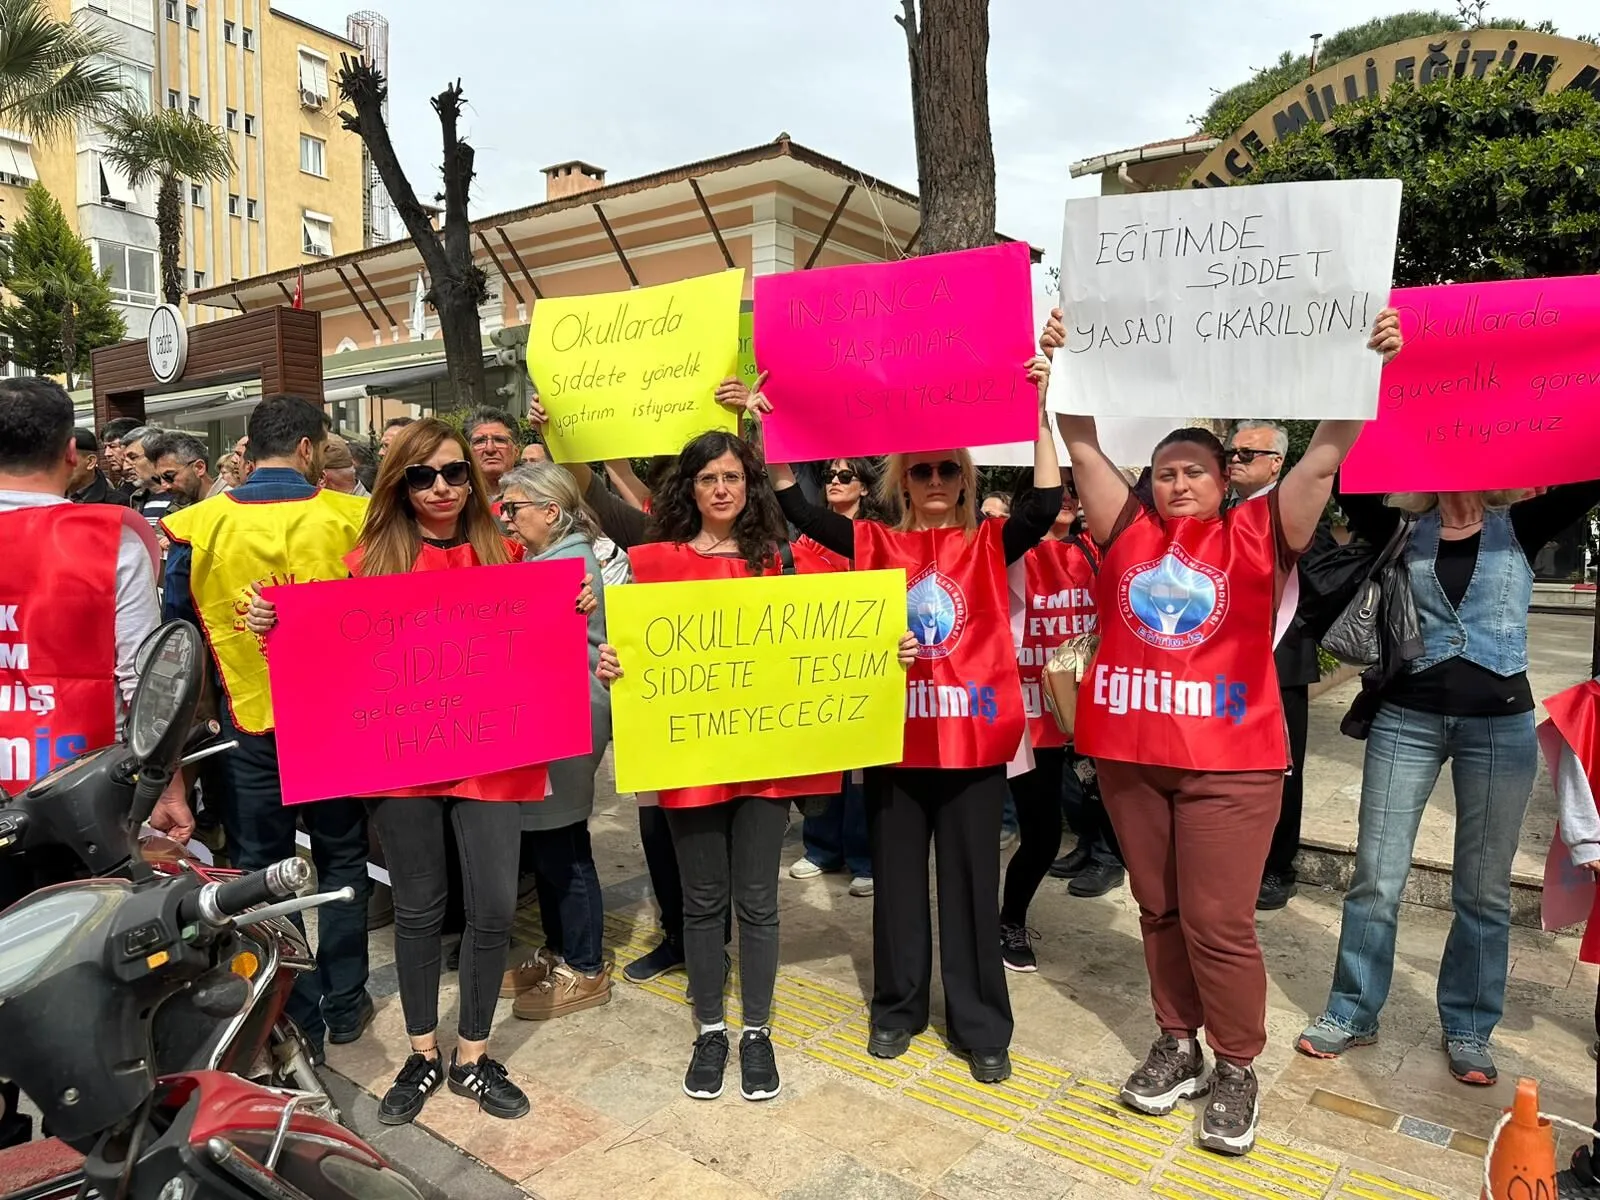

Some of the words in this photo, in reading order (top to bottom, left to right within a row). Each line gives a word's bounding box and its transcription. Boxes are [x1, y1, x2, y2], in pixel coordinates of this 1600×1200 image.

[1096, 215, 1264, 265] EĞİTİMDE
[1186, 249, 1332, 289] ŞİDDET
[551, 295, 683, 352] Okullarda
[1069, 313, 1173, 353] YASASI
[1196, 292, 1369, 343] ÇIKARILSIN!
[646, 599, 886, 657] OKULLARIMIZI
[642, 660, 756, 703] ŞİDDETE
[790, 650, 888, 686] TESLİM
[670, 695, 869, 742] ETMEYECEĞİZ
[905, 680, 998, 726] itimiş
